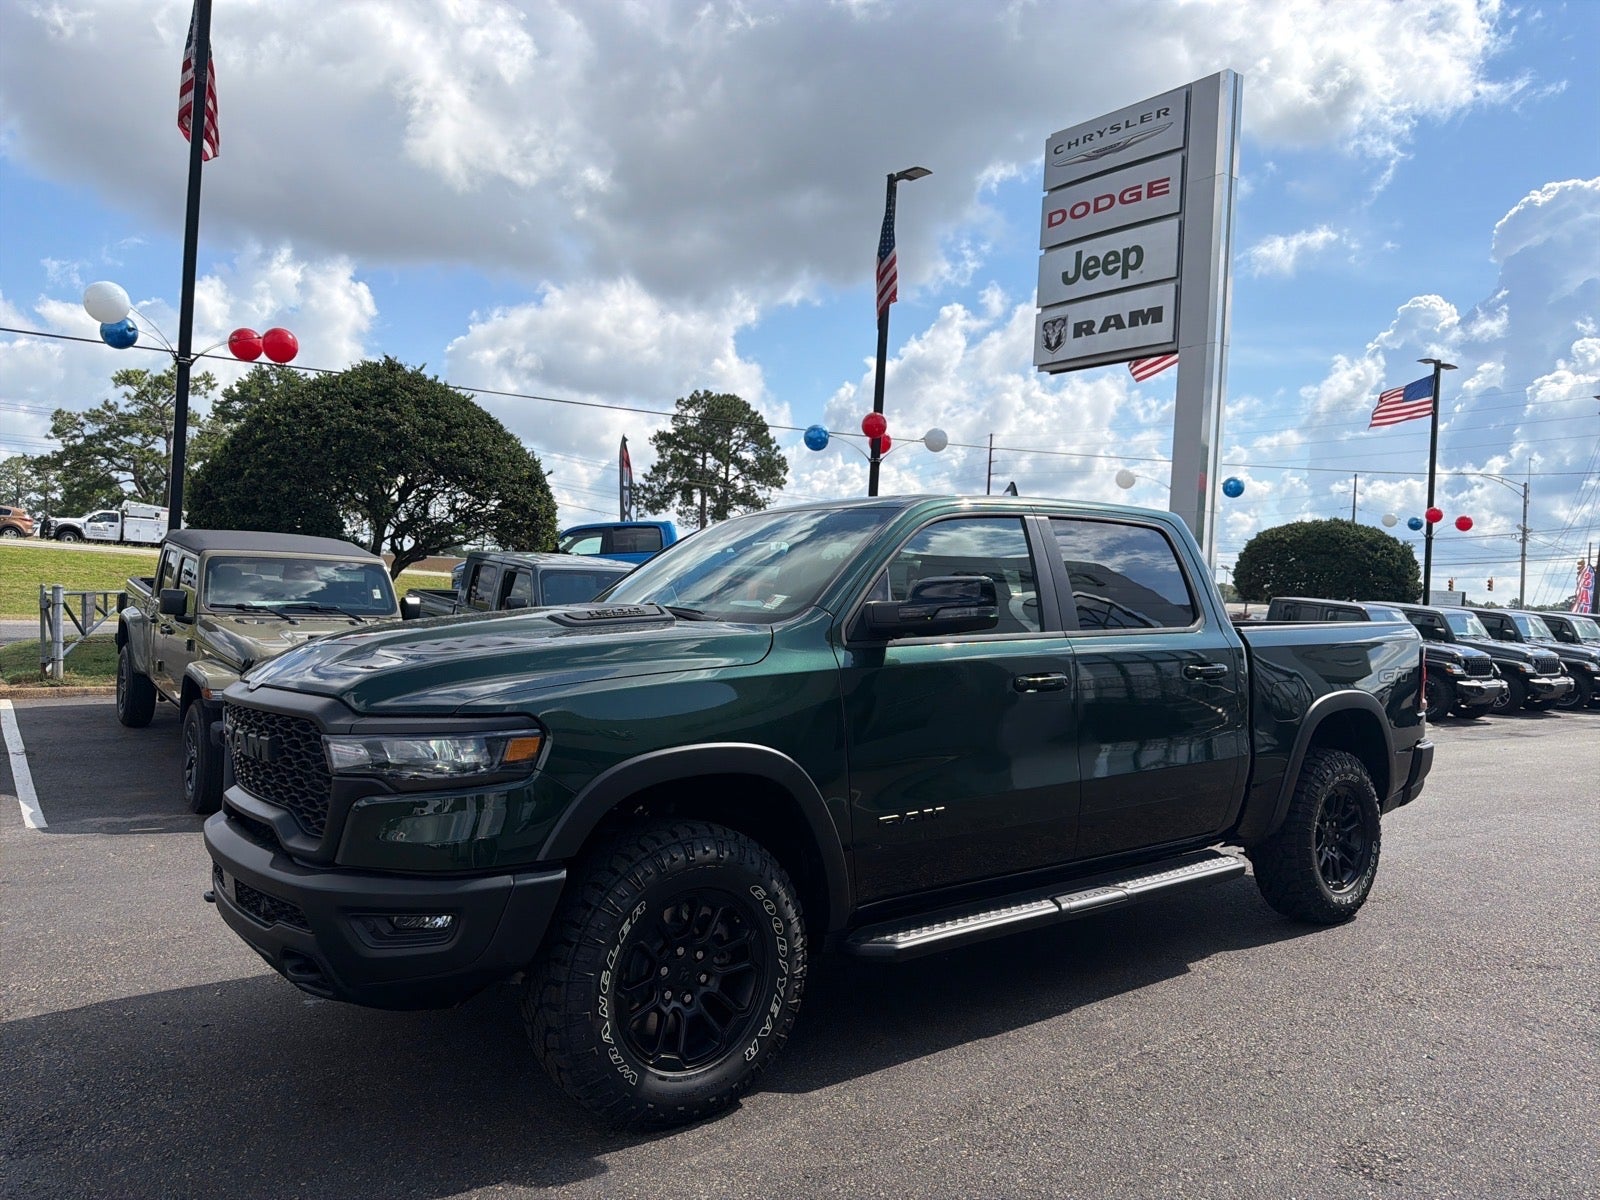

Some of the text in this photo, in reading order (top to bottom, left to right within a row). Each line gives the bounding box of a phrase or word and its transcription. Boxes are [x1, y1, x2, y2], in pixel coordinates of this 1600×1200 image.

[1053, 106, 1171, 155] CHRYSLER
[1047, 177, 1171, 229] DODGE
[1061, 244, 1144, 286] Jeep
[1072, 305, 1164, 339] RAM
[599, 900, 647, 1086] WRANGLER
[744, 885, 790, 1062] GOODYEAR
